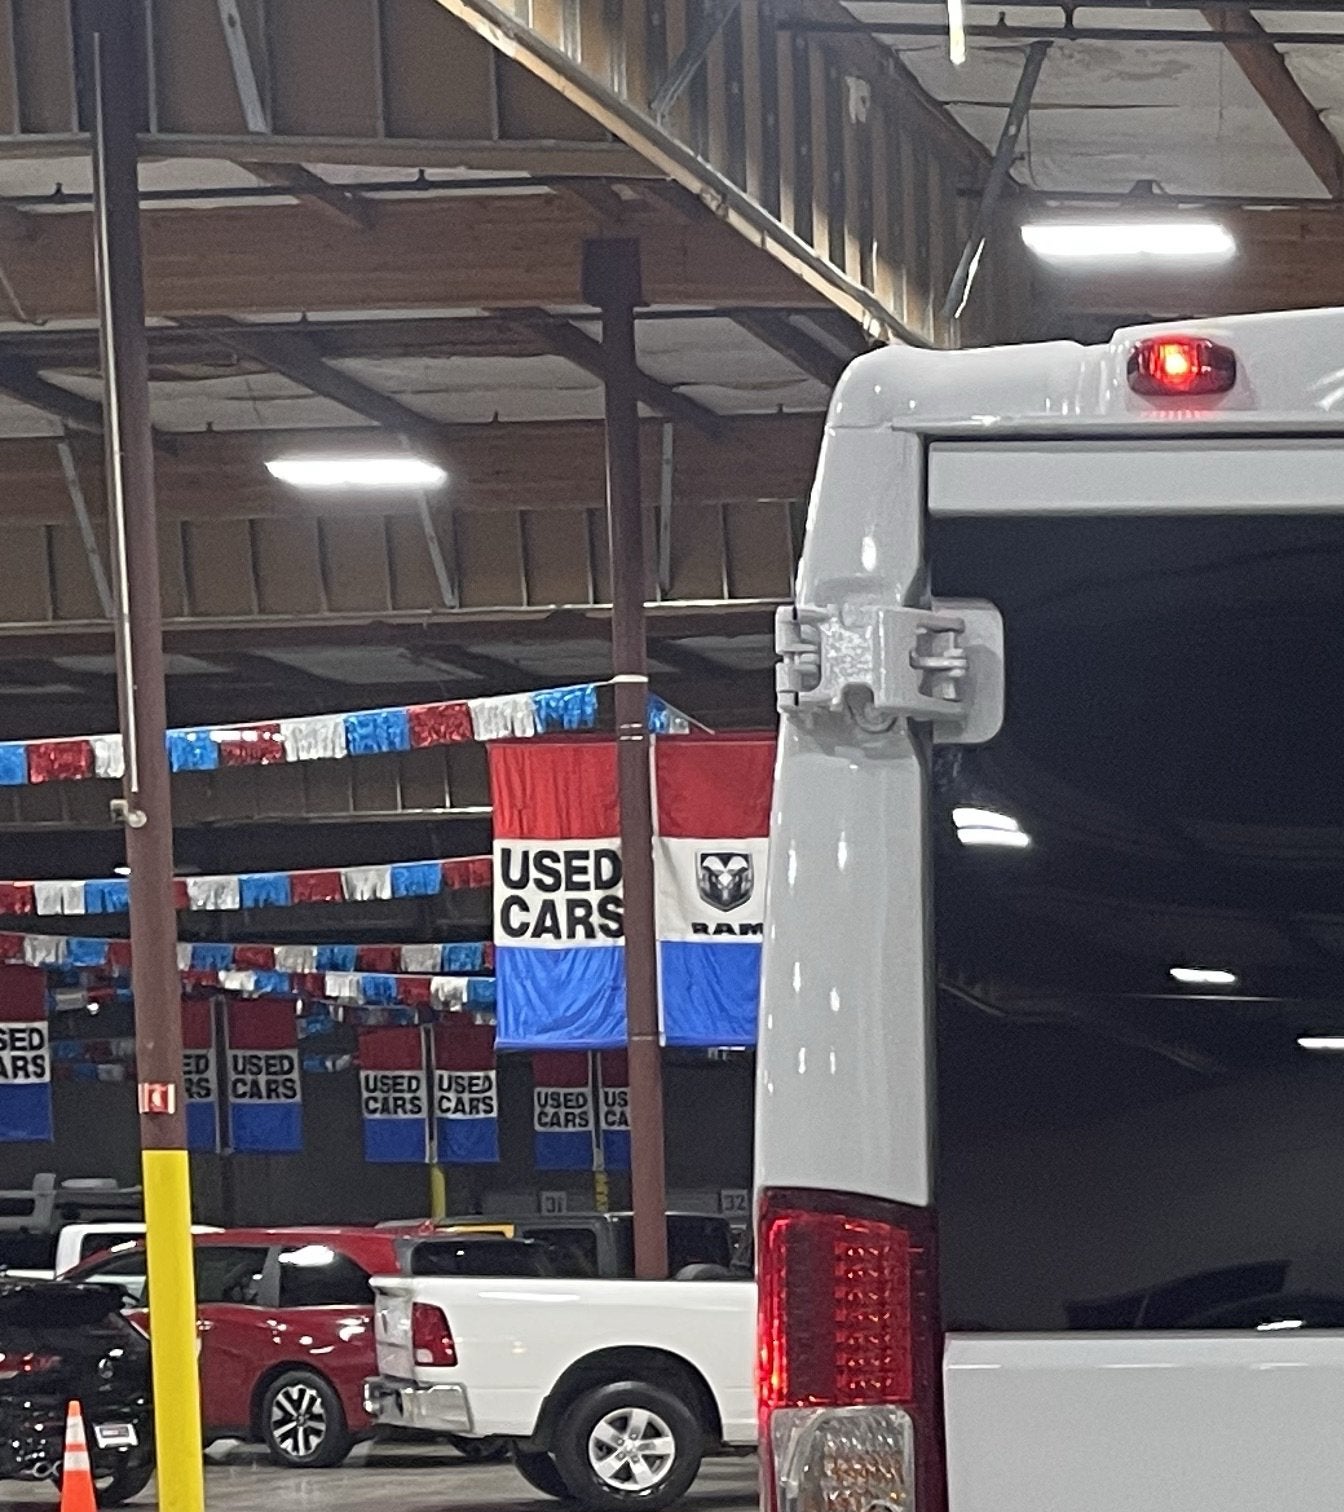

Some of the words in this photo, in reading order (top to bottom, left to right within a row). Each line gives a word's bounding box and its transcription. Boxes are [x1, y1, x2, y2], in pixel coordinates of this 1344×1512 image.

[500, 847, 623, 893] USED
[499, 895, 624, 940] CARS
[691, 922, 764, 936] RAM
[183, 1053, 210, 1075] ED
[231, 1054, 295, 1077] USED
[231, 1078, 298, 1100] CARS
[363, 1075, 421, 1095] USED
[437, 1073, 494, 1095] USED
[363, 1096, 423, 1116] CARS
[437, 1095, 495, 1116] CARS
[536, 1090, 588, 1110] USED
[603, 1090, 629, 1109] US
[536, 1111, 590, 1128] CARS
[603, 1109, 629, 1127] CA
